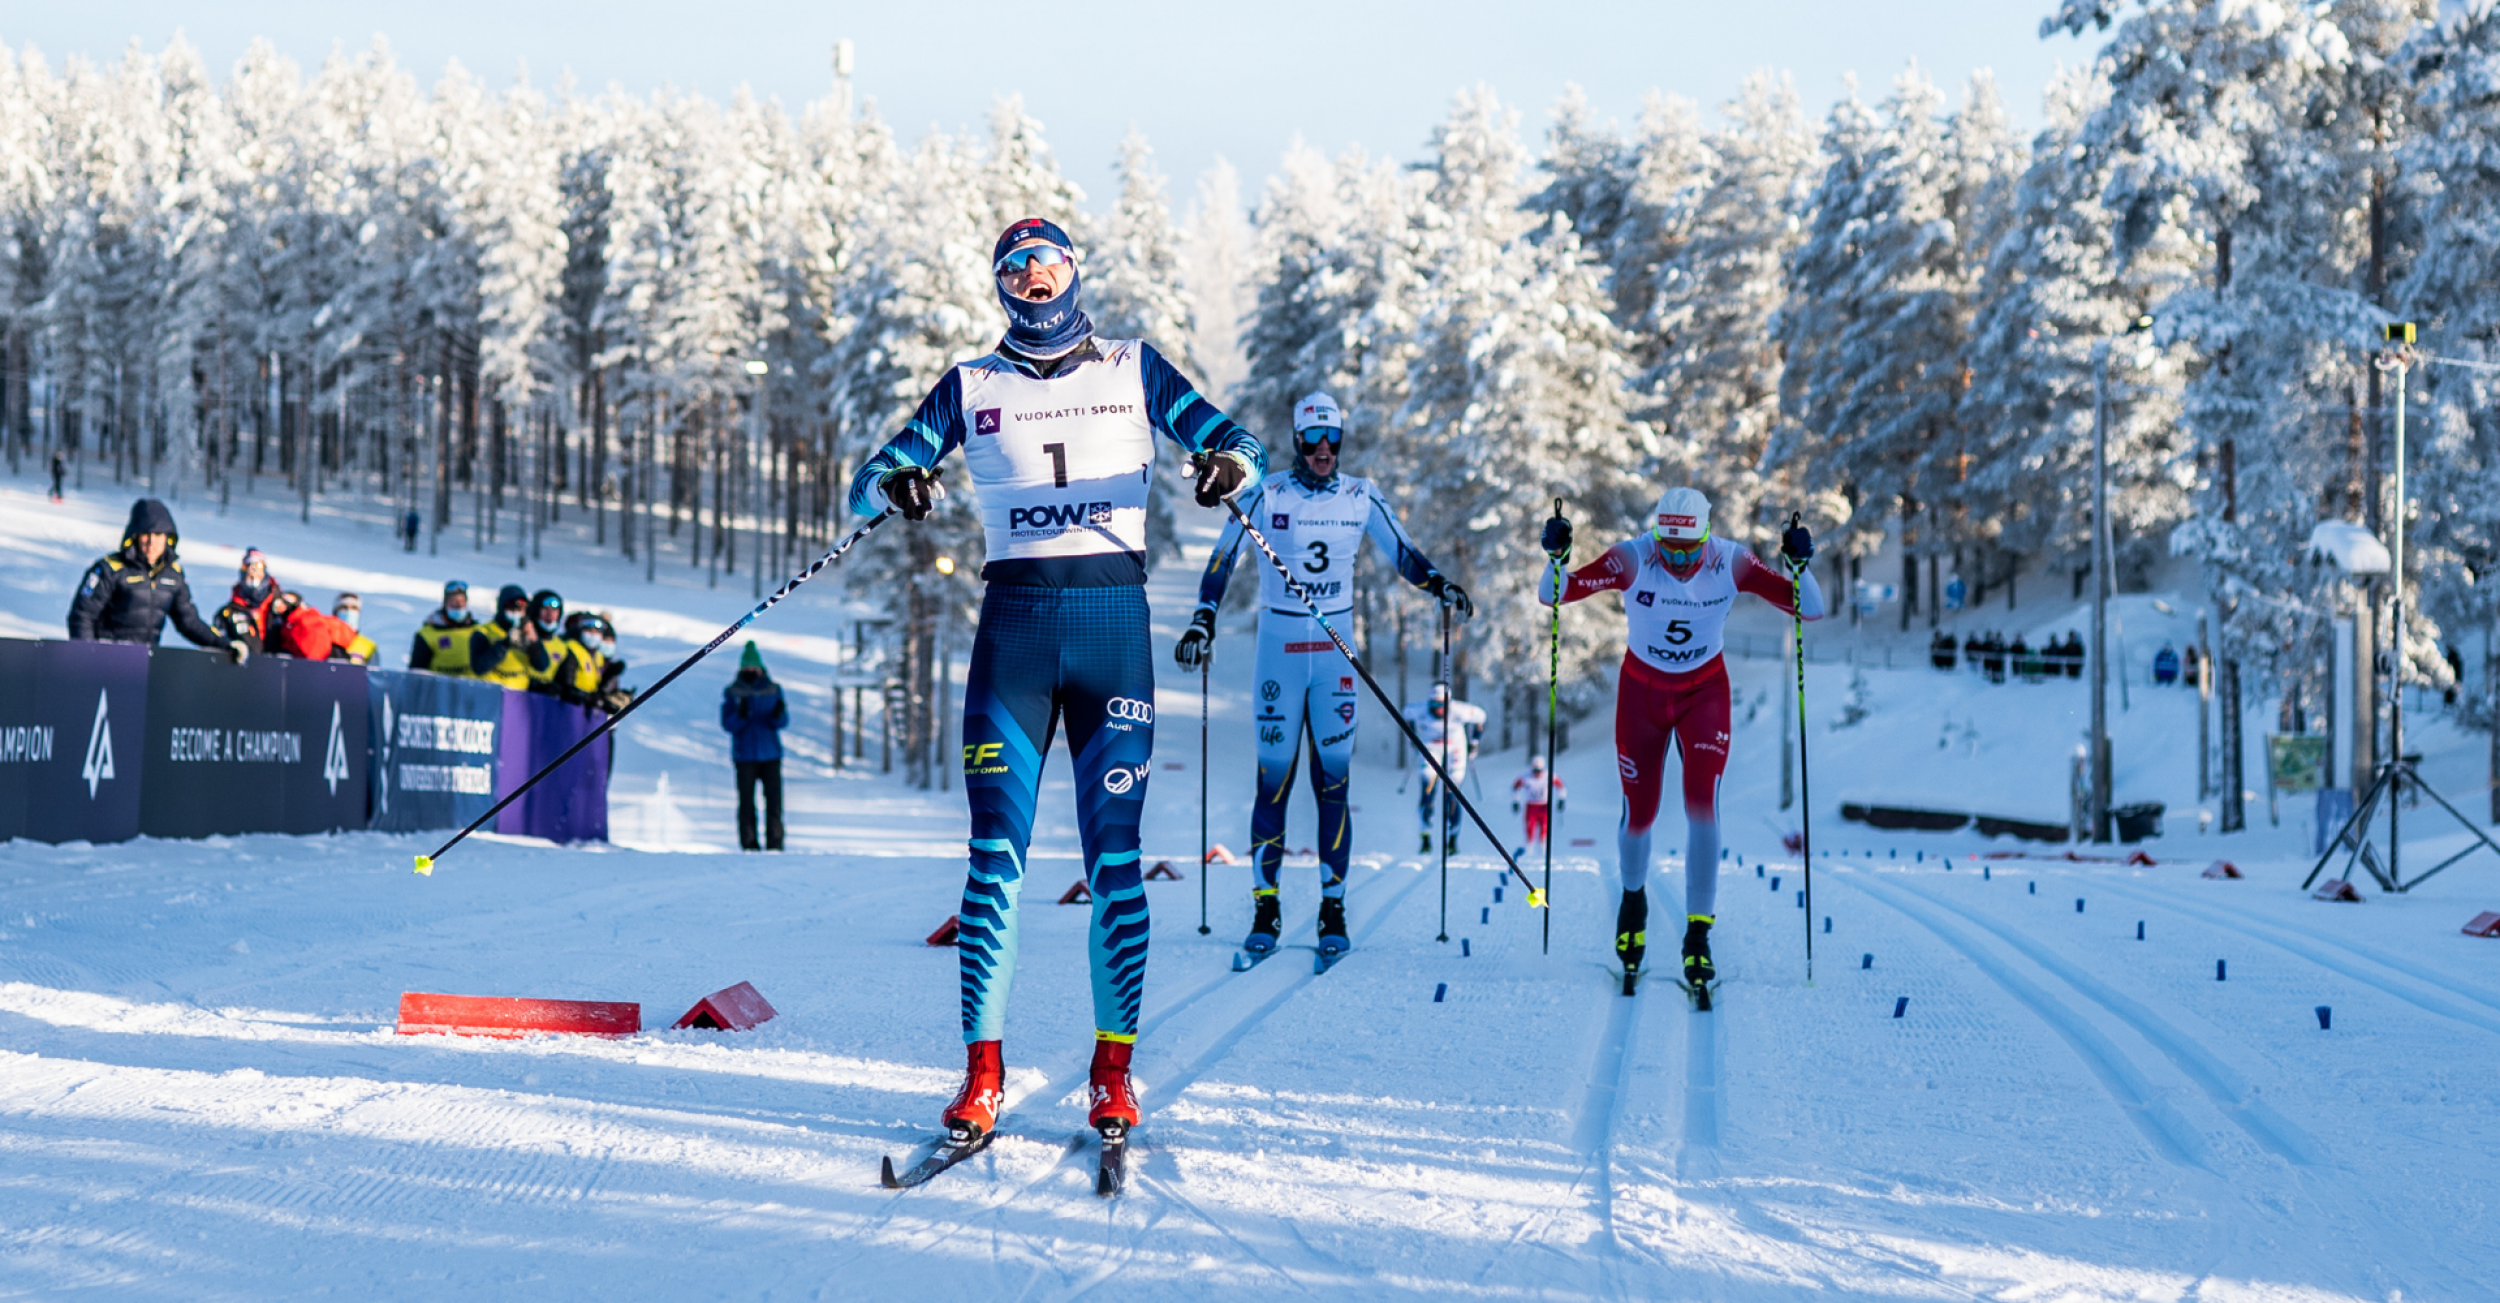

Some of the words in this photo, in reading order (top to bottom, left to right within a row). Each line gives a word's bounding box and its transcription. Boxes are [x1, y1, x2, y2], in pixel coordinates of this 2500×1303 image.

[1020, 310, 1064, 329] HALTI
[1015, 408, 1086, 422] VUOKATTI
[1091, 404, 1134, 415] SPORT
[1043, 442, 1068, 488] 1
[1010, 503, 1087, 530] POW
[1297, 519, 1338, 527] VUOKATTI
[1303, 540, 1330, 573] 3
[1702, 596, 1729, 607] SPORT
[1664, 619, 1693, 646] 5
[1648, 645, 1695, 661] POW
[1105, 721, 1133, 732] Audi
[1261, 725, 1285, 746] life
[171, 728, 220, 761] BECOME
[223, 730, 233, 761] A
[237, 730, 302, 763] CHAMPION
